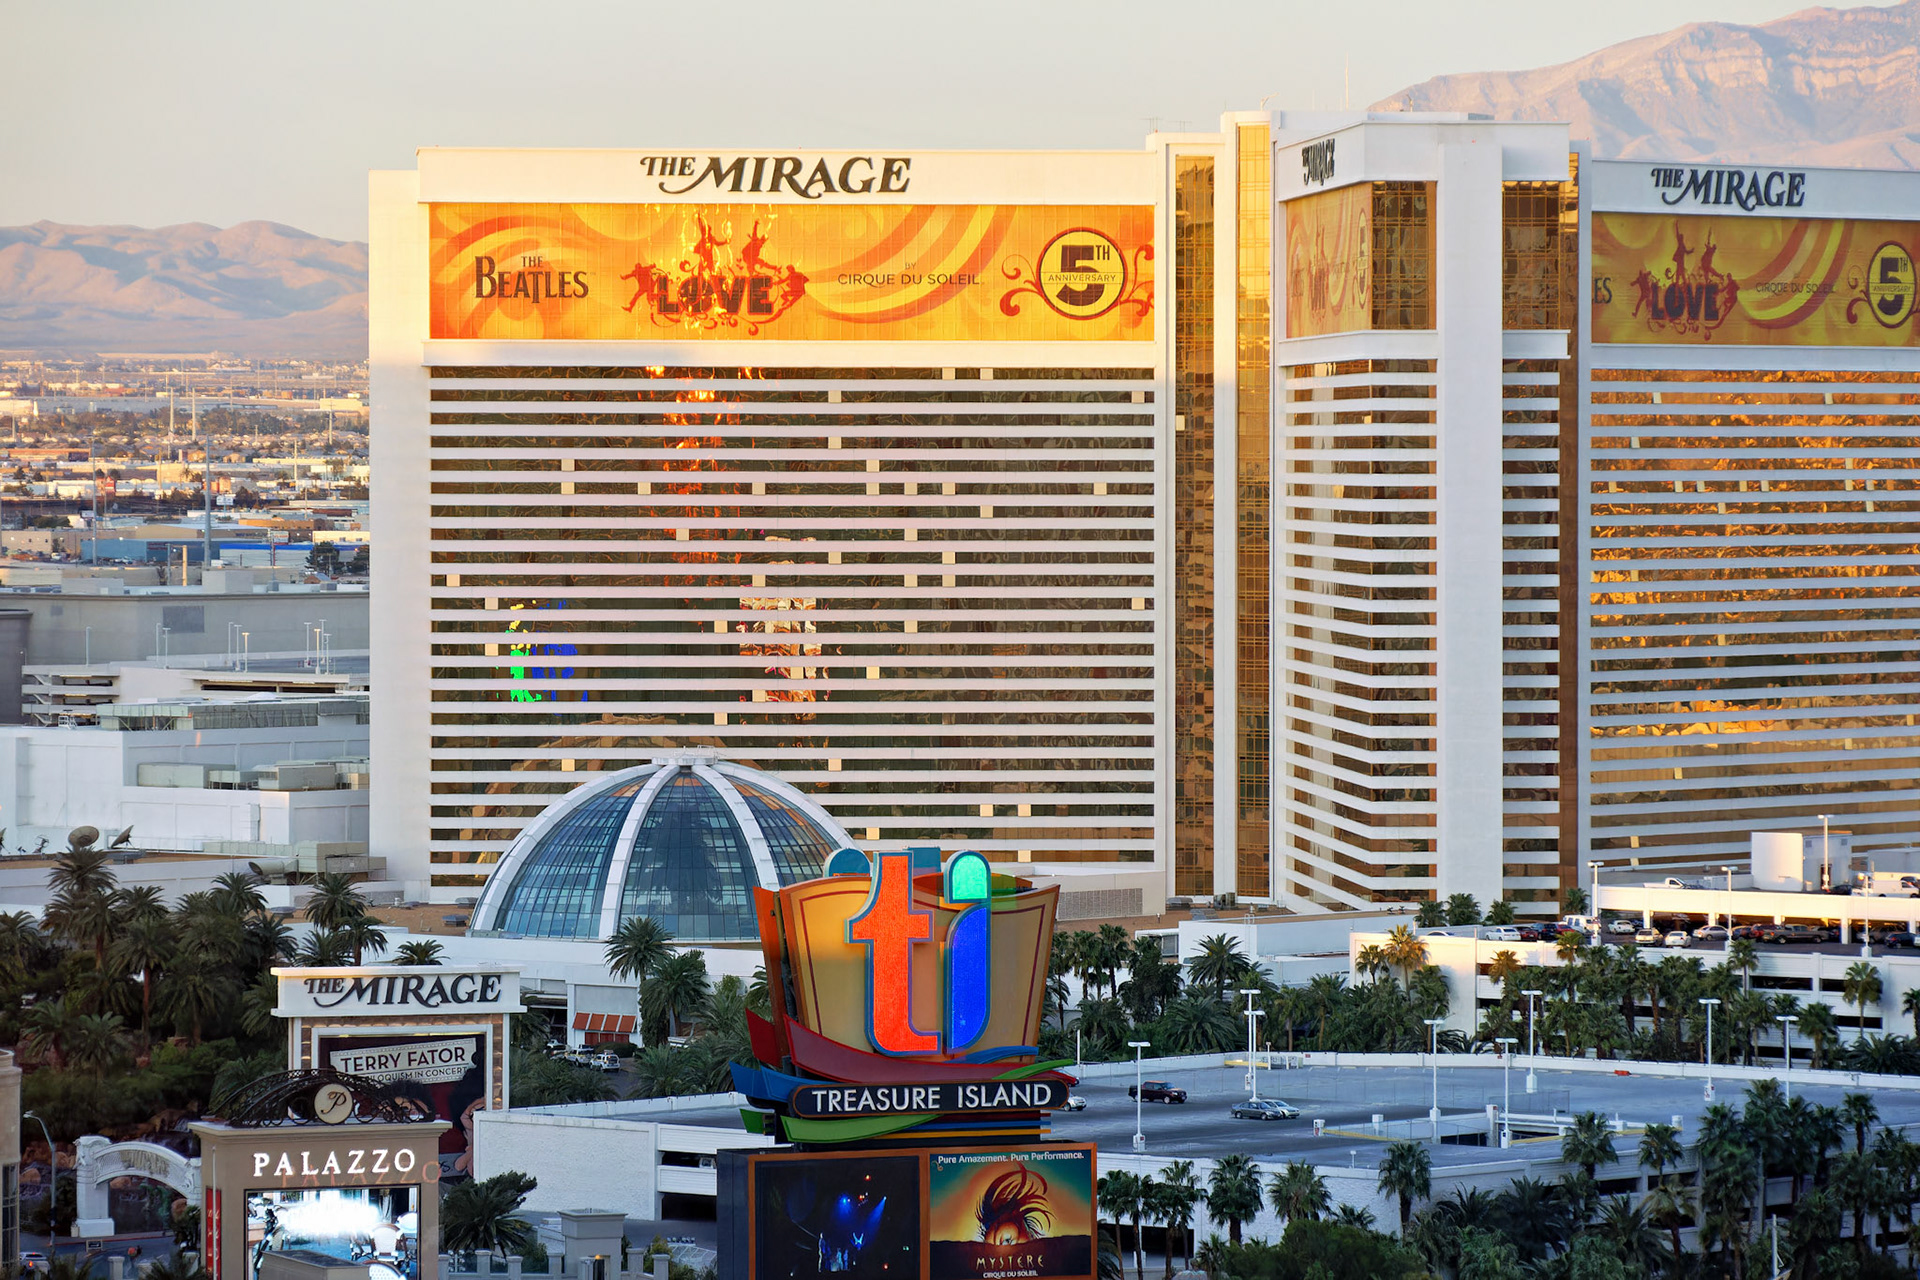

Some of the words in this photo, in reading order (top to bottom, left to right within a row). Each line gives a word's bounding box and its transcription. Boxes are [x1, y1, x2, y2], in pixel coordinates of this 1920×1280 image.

[639, 156, 696, 176] THE
[658, 156, 912, 199] MIRAGE
[1651, 168, 1684, 188] THE
[1661, 169, 1806, 212] MIRAGE
[521, 256, 543, 268] THE
[905, 262, 916, 270] BY
[475, 256, 589, 303] BEATLES
[838, 274, 895, 288] CIRQUE
[901, 274, 922, 285] DU
[927, 274, 980, 285] SOLEIL
[1048, 274, 1116, 282] ANNIVERSARY
[657, 275, 774, 315] LOVE
[1756, 283, 1787, 295] CIRQUE
[1790, 283, 1803, 293] DU
[1650, 282, 1719, 321] LOVE
[304, 978, 344, 994] THE
[313, 974, 501, 1008] MIRAGE
[340, 1053, 402, 1072] TERRY
[408, 1047, 465, 1067] FATOR
[426, 1067, 467, 1078] CONCERT
[811, 1087, 941, 1112] TREASURE
[957, 1083, 1051, 1109] ISLAND
[253, 1148, 416, 1177] PALAZZO
[938, 1155, 957, 1164] Pure
[959, 1155, 1008, 1163] Amazement.
[1010, 1153, 1029, 1162] Pure
[1031, 1151, 1084, 1161] Performance.
[983, 1271, 1006, 1279] CIRQUE
